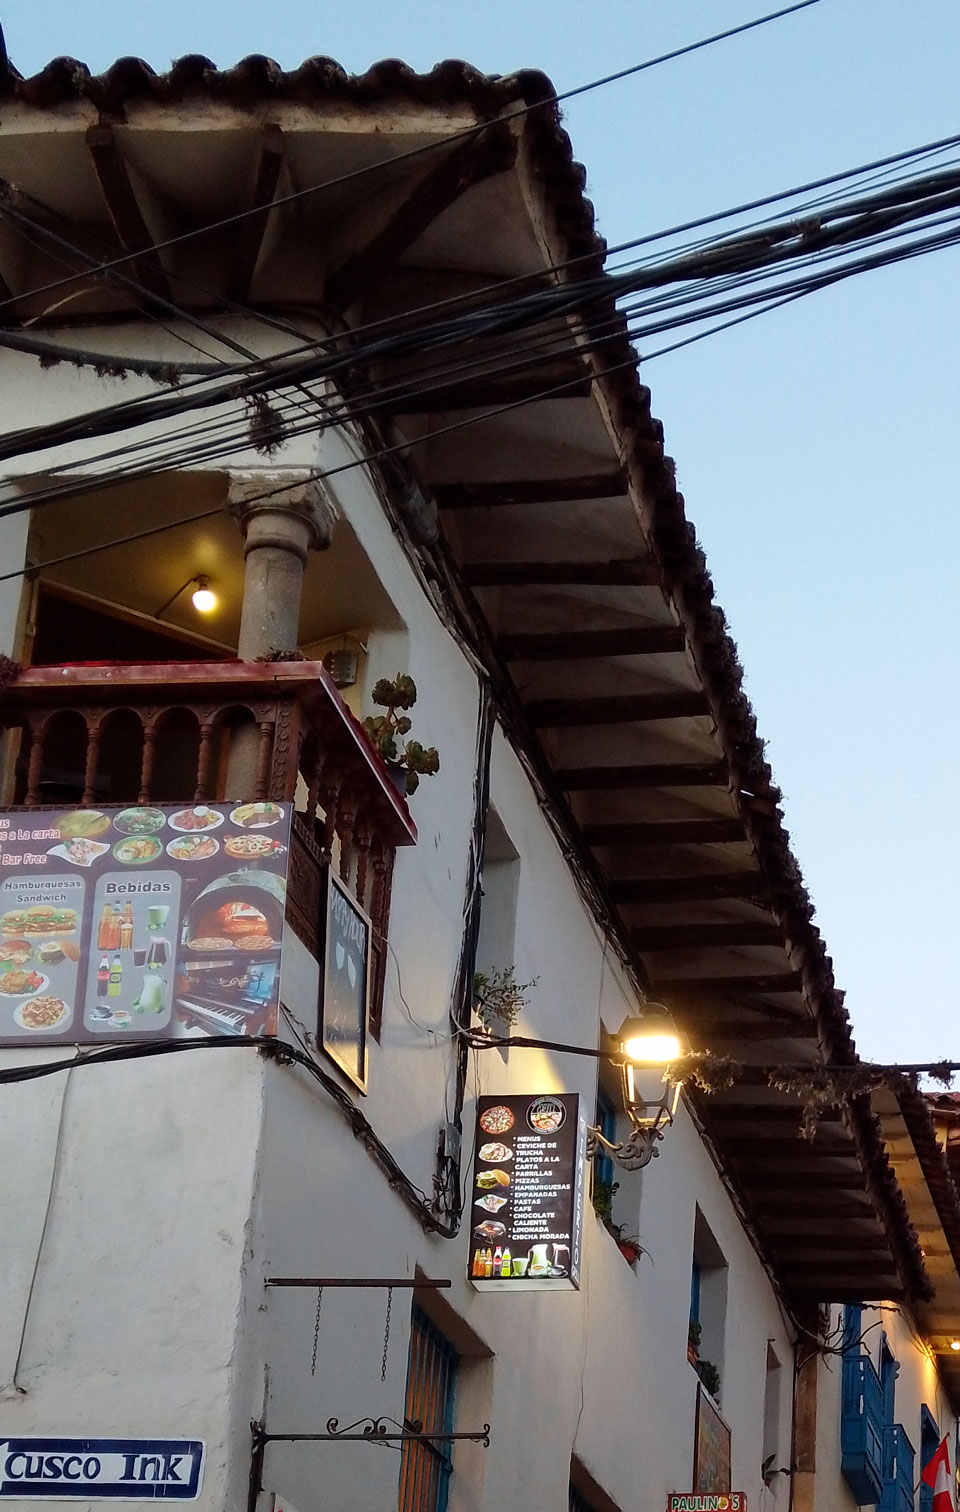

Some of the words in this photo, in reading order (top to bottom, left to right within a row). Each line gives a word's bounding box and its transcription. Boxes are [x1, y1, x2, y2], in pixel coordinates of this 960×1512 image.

[17, 829, 31, 840] La
[31, 829, 60, 840] carta
[2, 854, 22, 865] Bar
[23, 852, 47, 864] Free
[106, 881, 171, 894] Bebidas
[16, 893, 67, 903] Sandwich
[119, 1453, 185, 1481] Ink
